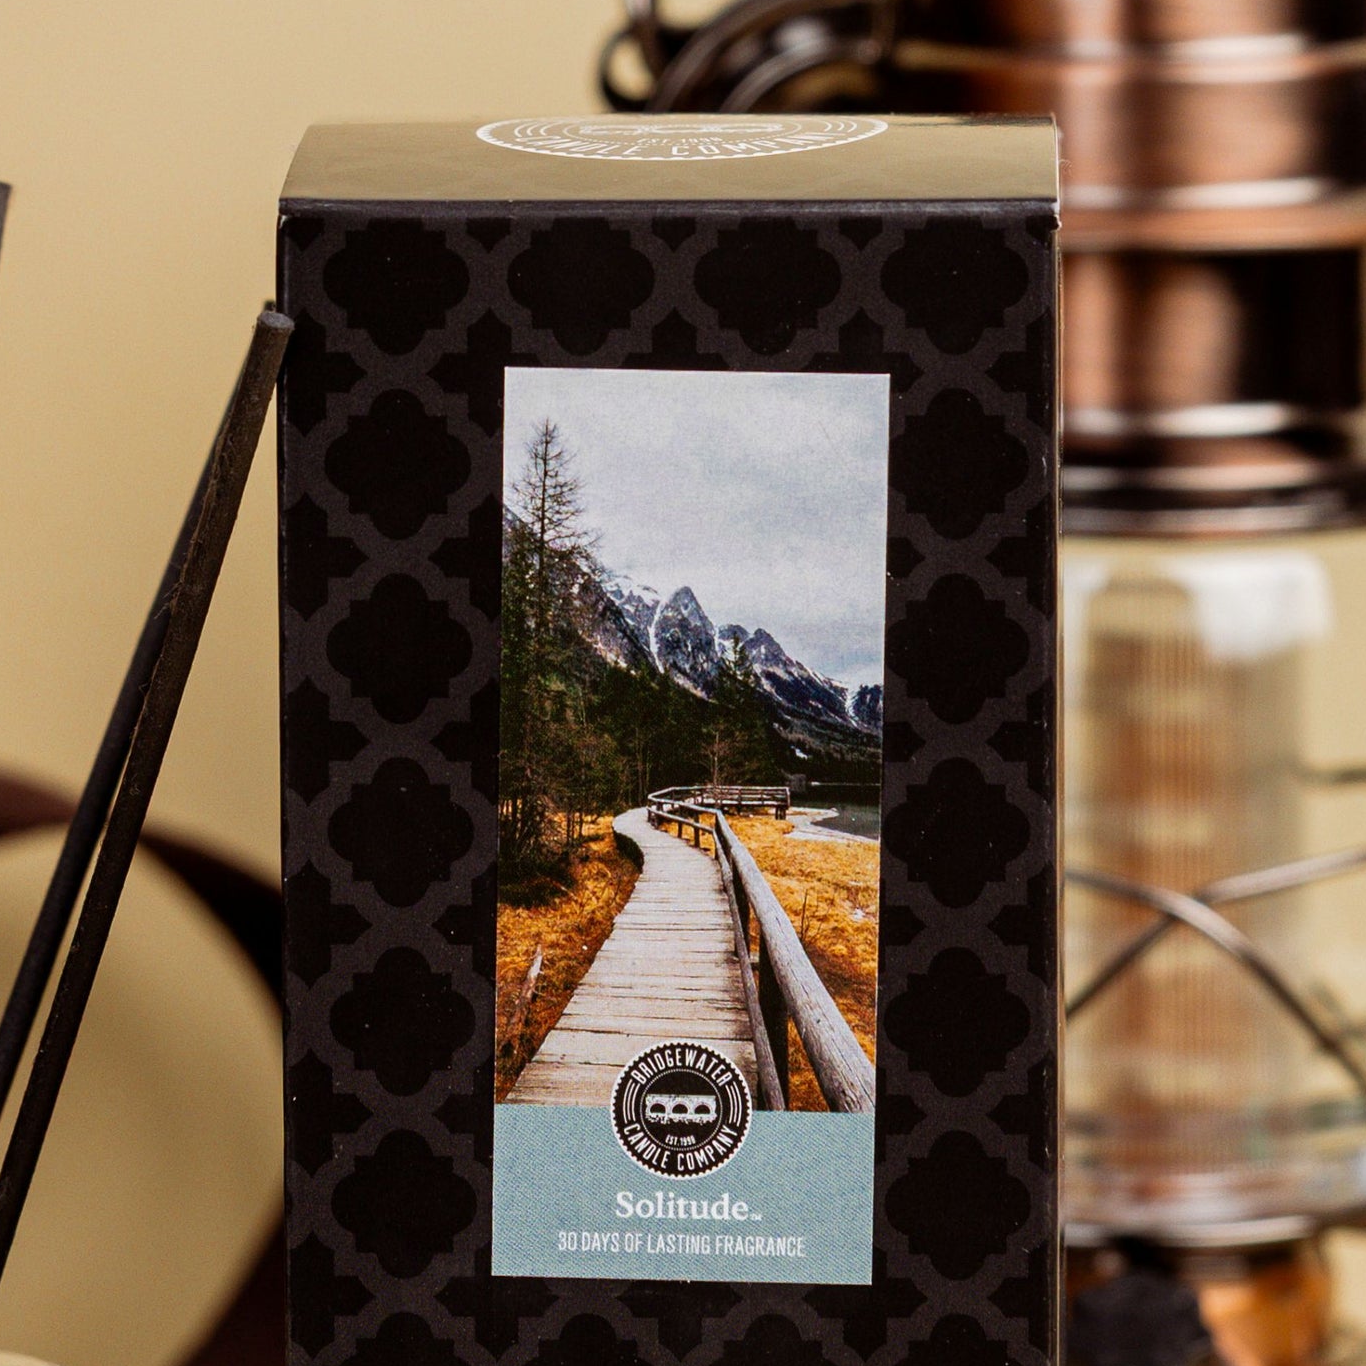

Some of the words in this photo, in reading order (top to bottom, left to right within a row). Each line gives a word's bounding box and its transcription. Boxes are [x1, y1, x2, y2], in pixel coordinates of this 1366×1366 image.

[515, 136, 649, 155] CANDLE
[631, 1048, 733, 1087] BRIDGEWATER
[623, 1123, 671, 1169] CANDLE
[677, 1124, 738, 1171] COMPANY
[558, 1231, 577, 1251] 30
[581, 1231, 620, 1253] DAYS
[624, 1233, 643, 1253] OF
[647, 1234, 711, 1255] LASTING
[715, 1235, 806, 1258] FRAGRANCE
